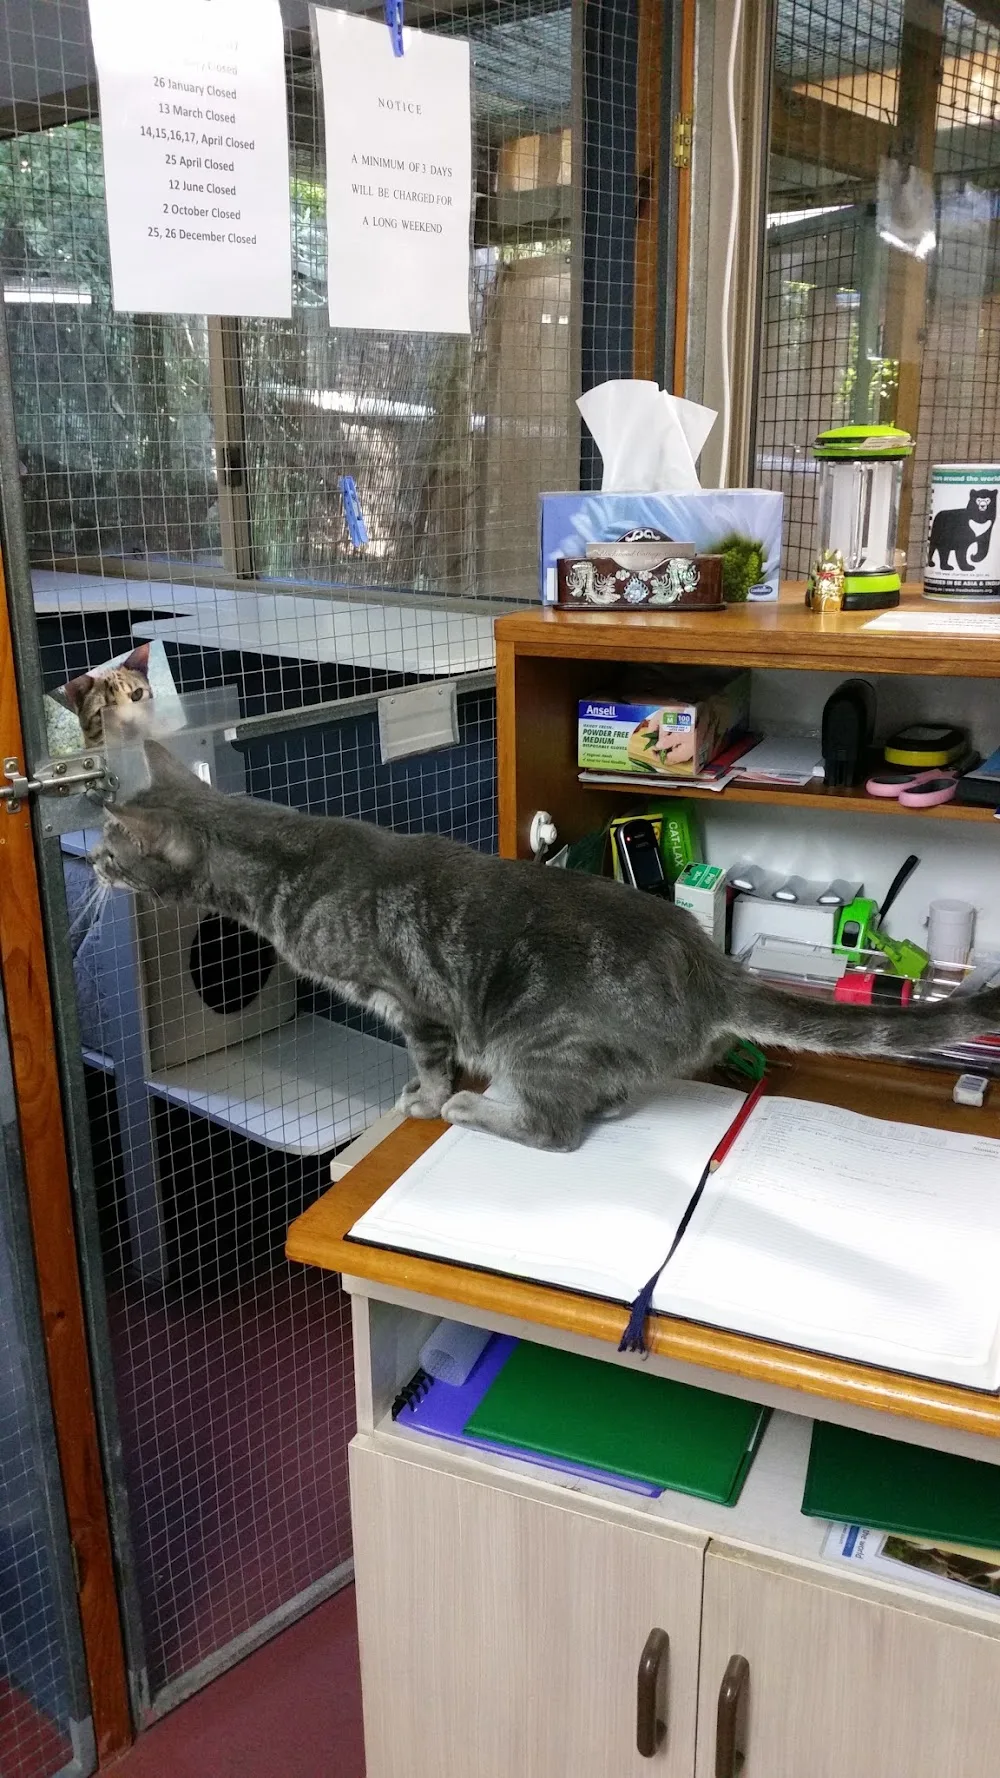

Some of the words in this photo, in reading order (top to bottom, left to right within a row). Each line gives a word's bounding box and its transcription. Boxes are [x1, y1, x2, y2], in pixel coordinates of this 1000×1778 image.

[153, 76, 166, 88] 26
[168, 79, 205, 96] January
[207, 85, 237, 99] Closed
[159, 103, 171, 114] 13
[173, 105, 204, 118] March
[206, 110, 236, 124] Closed
[377, 97, 423, 115] NOTICE
[201, 133, 224, 147] April
[225, 137, 256, 150] Closed
[165, 154, 178, 165] 25
[180, 156, 203, 169] April
[204, 159, 235, 172] Closed
[351, 154, 358, 165] A
[362, 155, 405, 170] MINIMUM
[409, 162, 421, 172] OF
[421, 164, 427, 174] 3
[430, 165, 453, 177] DAYS
[169, 179, 181, 190] 12
[183, 180, 205, 192] June
[206, 183, 237, 195] Closed
[352, 184, 374, 196] WILL
[378, 187, 390, 198] BE
[393, 190, 435, 203] CHARGED
[436, 195, 453, 206] FOR
[162, 203, 170, 215] 2
[171, 204, 210, 217] October
[212, 208, 241, 220] Closed
[362, 216, 369, 226] A
[373, 217, 398, 228] LONG
[402, 220, 443, 233] WEEKEND
[148, 227, 163, 239] 25,
[165, 228, 177, 239] 26
[179, 229, 226, 242] December
[228, 233, 257, 244] Closed
[586, 705, 616, 716] Ansell
[582, 728, 613, 738] POWDER
[613, 730, 630, 739] FREE
[582, 736, 615, 745] MEDIUM
[668, 821, 685, 867] CAT-LAX
[676, 899, 694, 909] PMP
[861, 1529, 870, 1540] the
[855, 1540, 866, 1560] world
